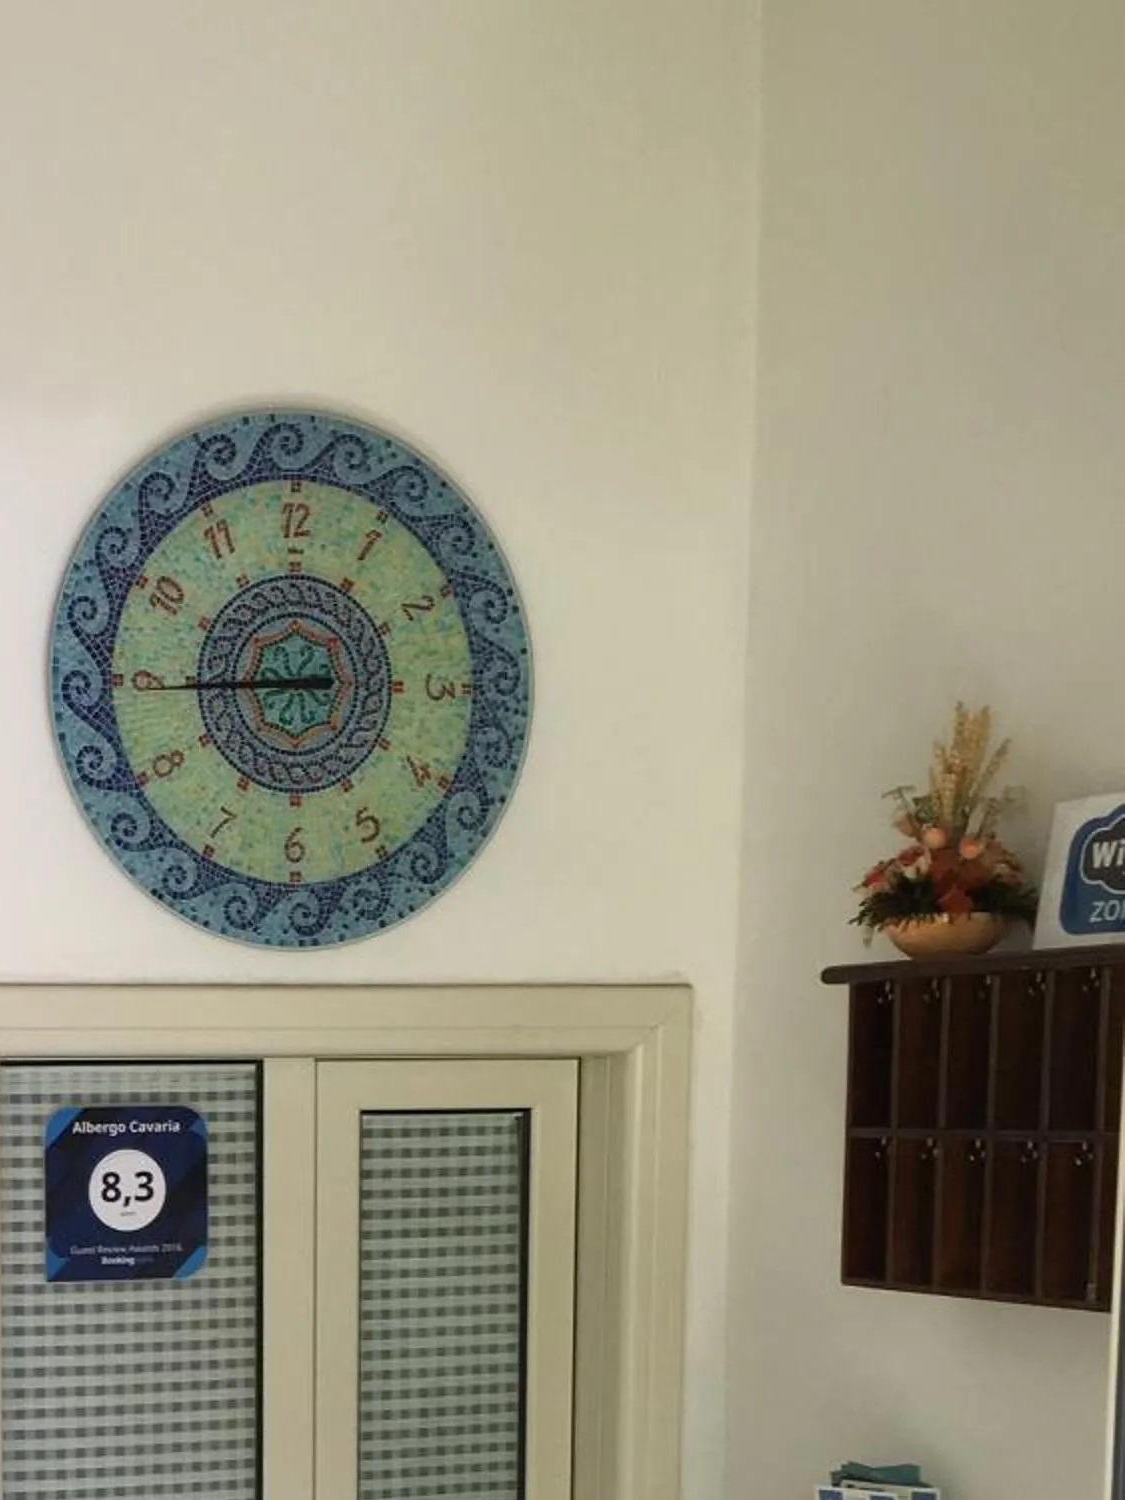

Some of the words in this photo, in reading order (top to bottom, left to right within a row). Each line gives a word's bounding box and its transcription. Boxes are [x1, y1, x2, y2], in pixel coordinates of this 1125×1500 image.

[282, 503, 311, 538] 12
[205, 519, 235, 559] 11
[358, 529, 382, 561] 1
[149, 576, 185, 616] 10
[401, 595, 435, 621] 2
[131, 670, 165, 691] 9
[425, 673, 456, 701] 3
[151, 749, 184, 778] 8
[405, 755, 430, 787] 4
[209, 806, 238, 838] 7
[356, 806, 380, 844] 5
[284, 827, 305, 864] 6
[1089, 899, 1125, 922] ZO
[72, 1121, 126, 1137] Albergo
[129, 1120, 181, 1134] Cavaria
[101, 1171, 154, 1208] 8,3
